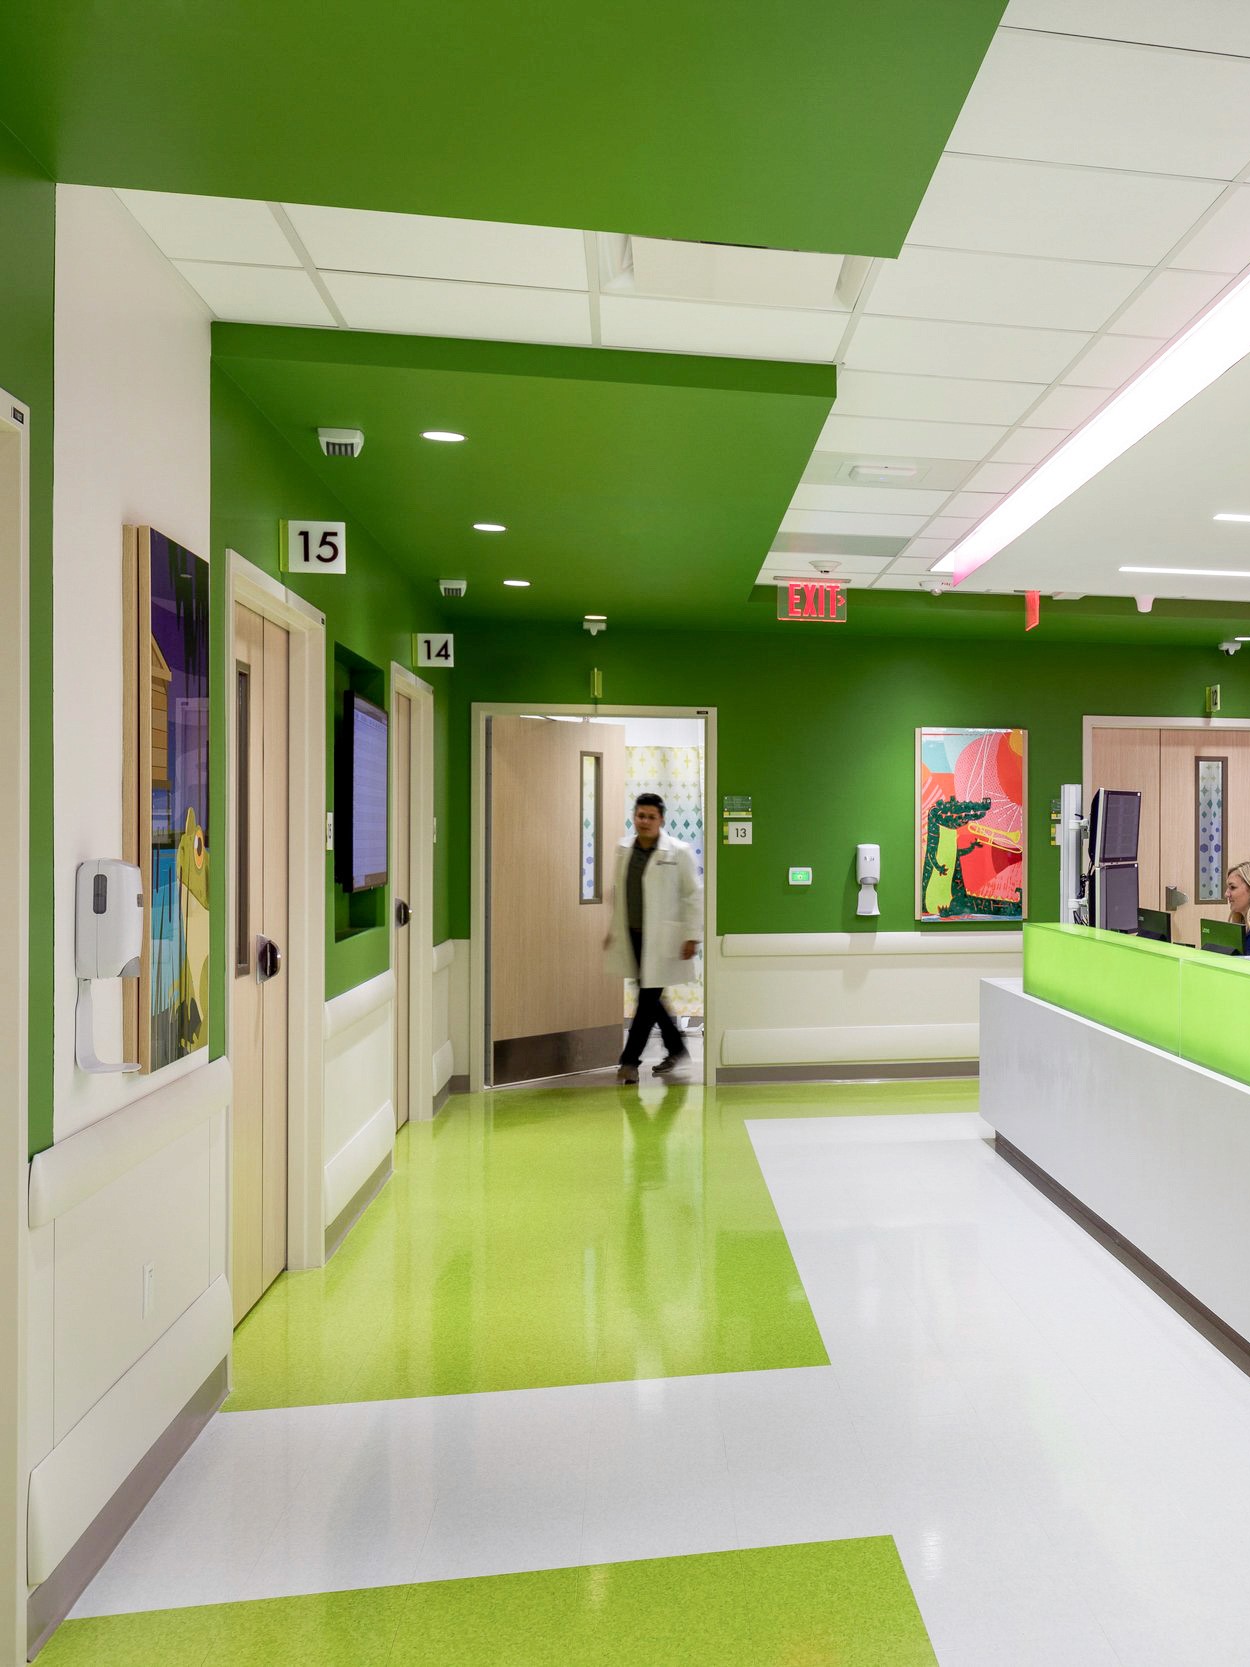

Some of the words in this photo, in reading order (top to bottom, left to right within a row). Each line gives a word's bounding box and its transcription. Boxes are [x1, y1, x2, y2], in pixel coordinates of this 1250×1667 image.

[298, 530, 339, 563] 15
[788, 583, 841, 618] EXIT
[423, 639, 451, 660] 14
[735, 827, 747, 838] 13
